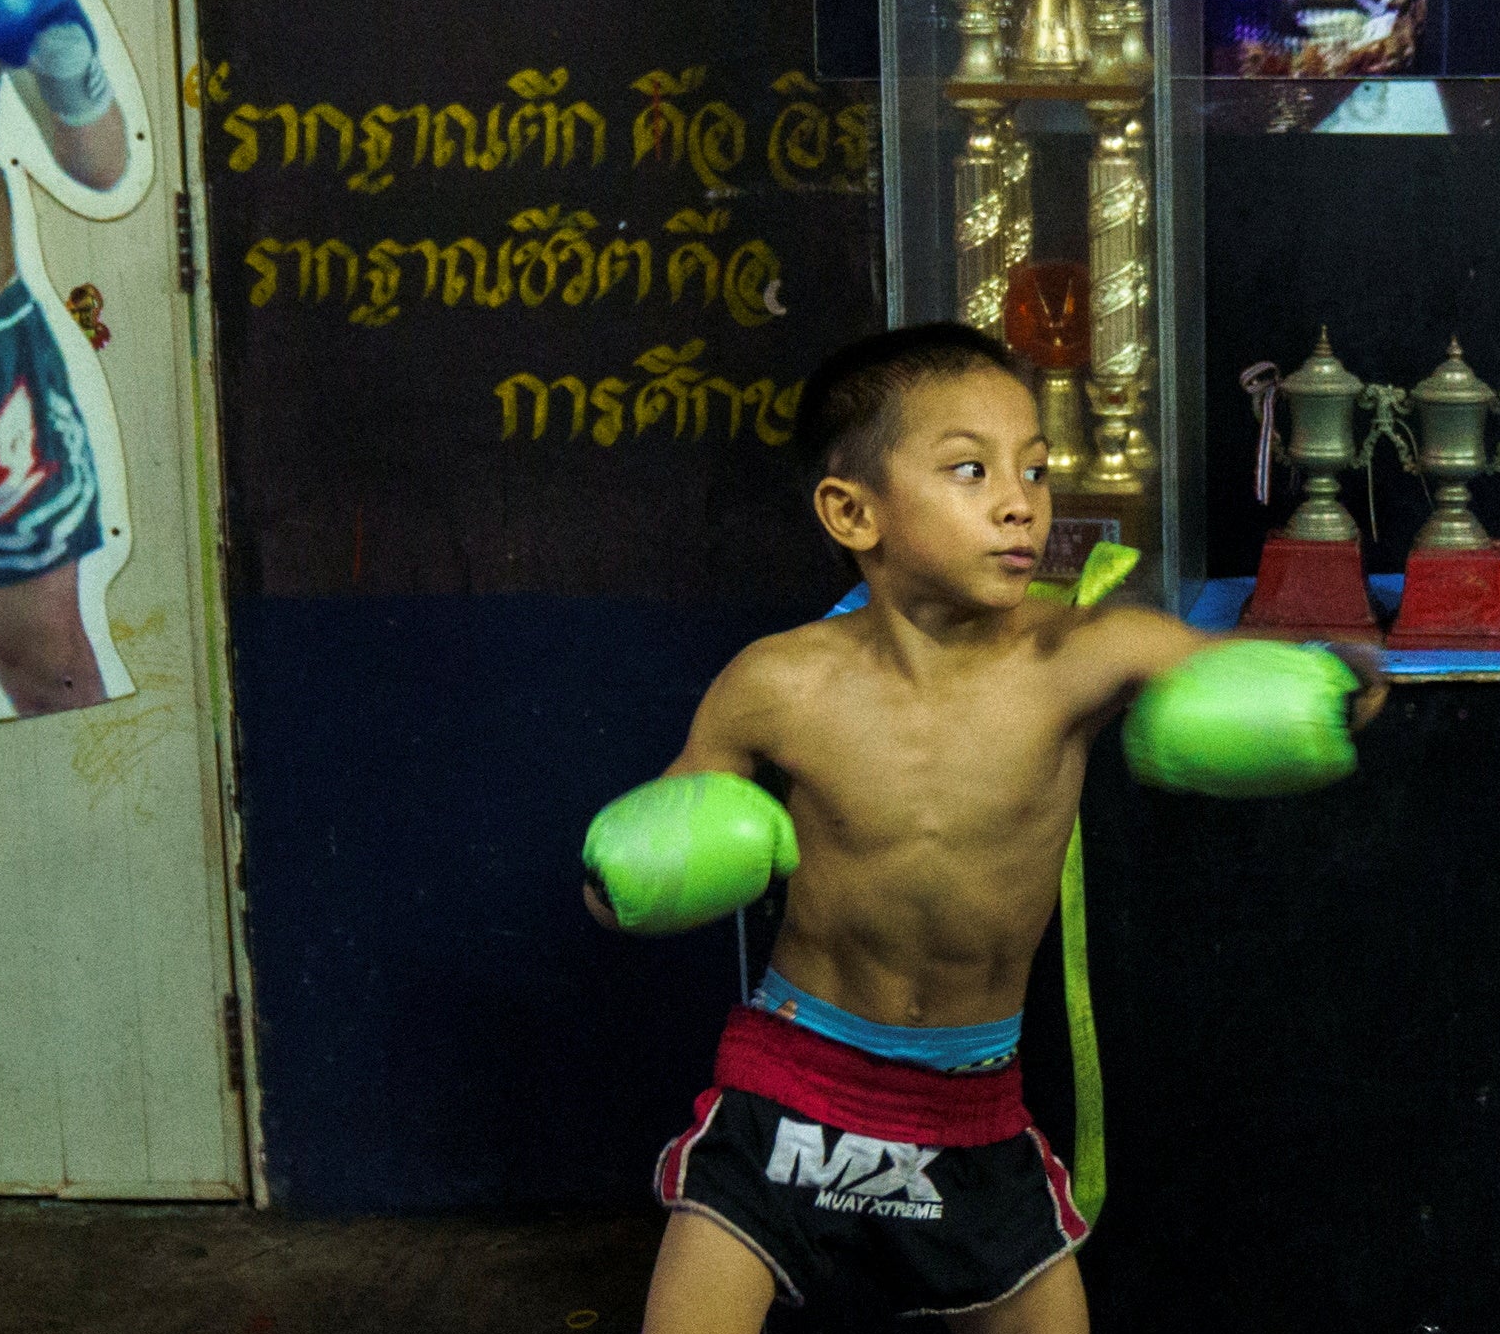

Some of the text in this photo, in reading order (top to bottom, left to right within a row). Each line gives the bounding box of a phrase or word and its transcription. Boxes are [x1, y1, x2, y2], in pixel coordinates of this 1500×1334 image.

[630, 66, 748, 191] คือ
[660, 208, 788, 327] คือ
[814, 1187, 944, 1220] MUAY XTREME
